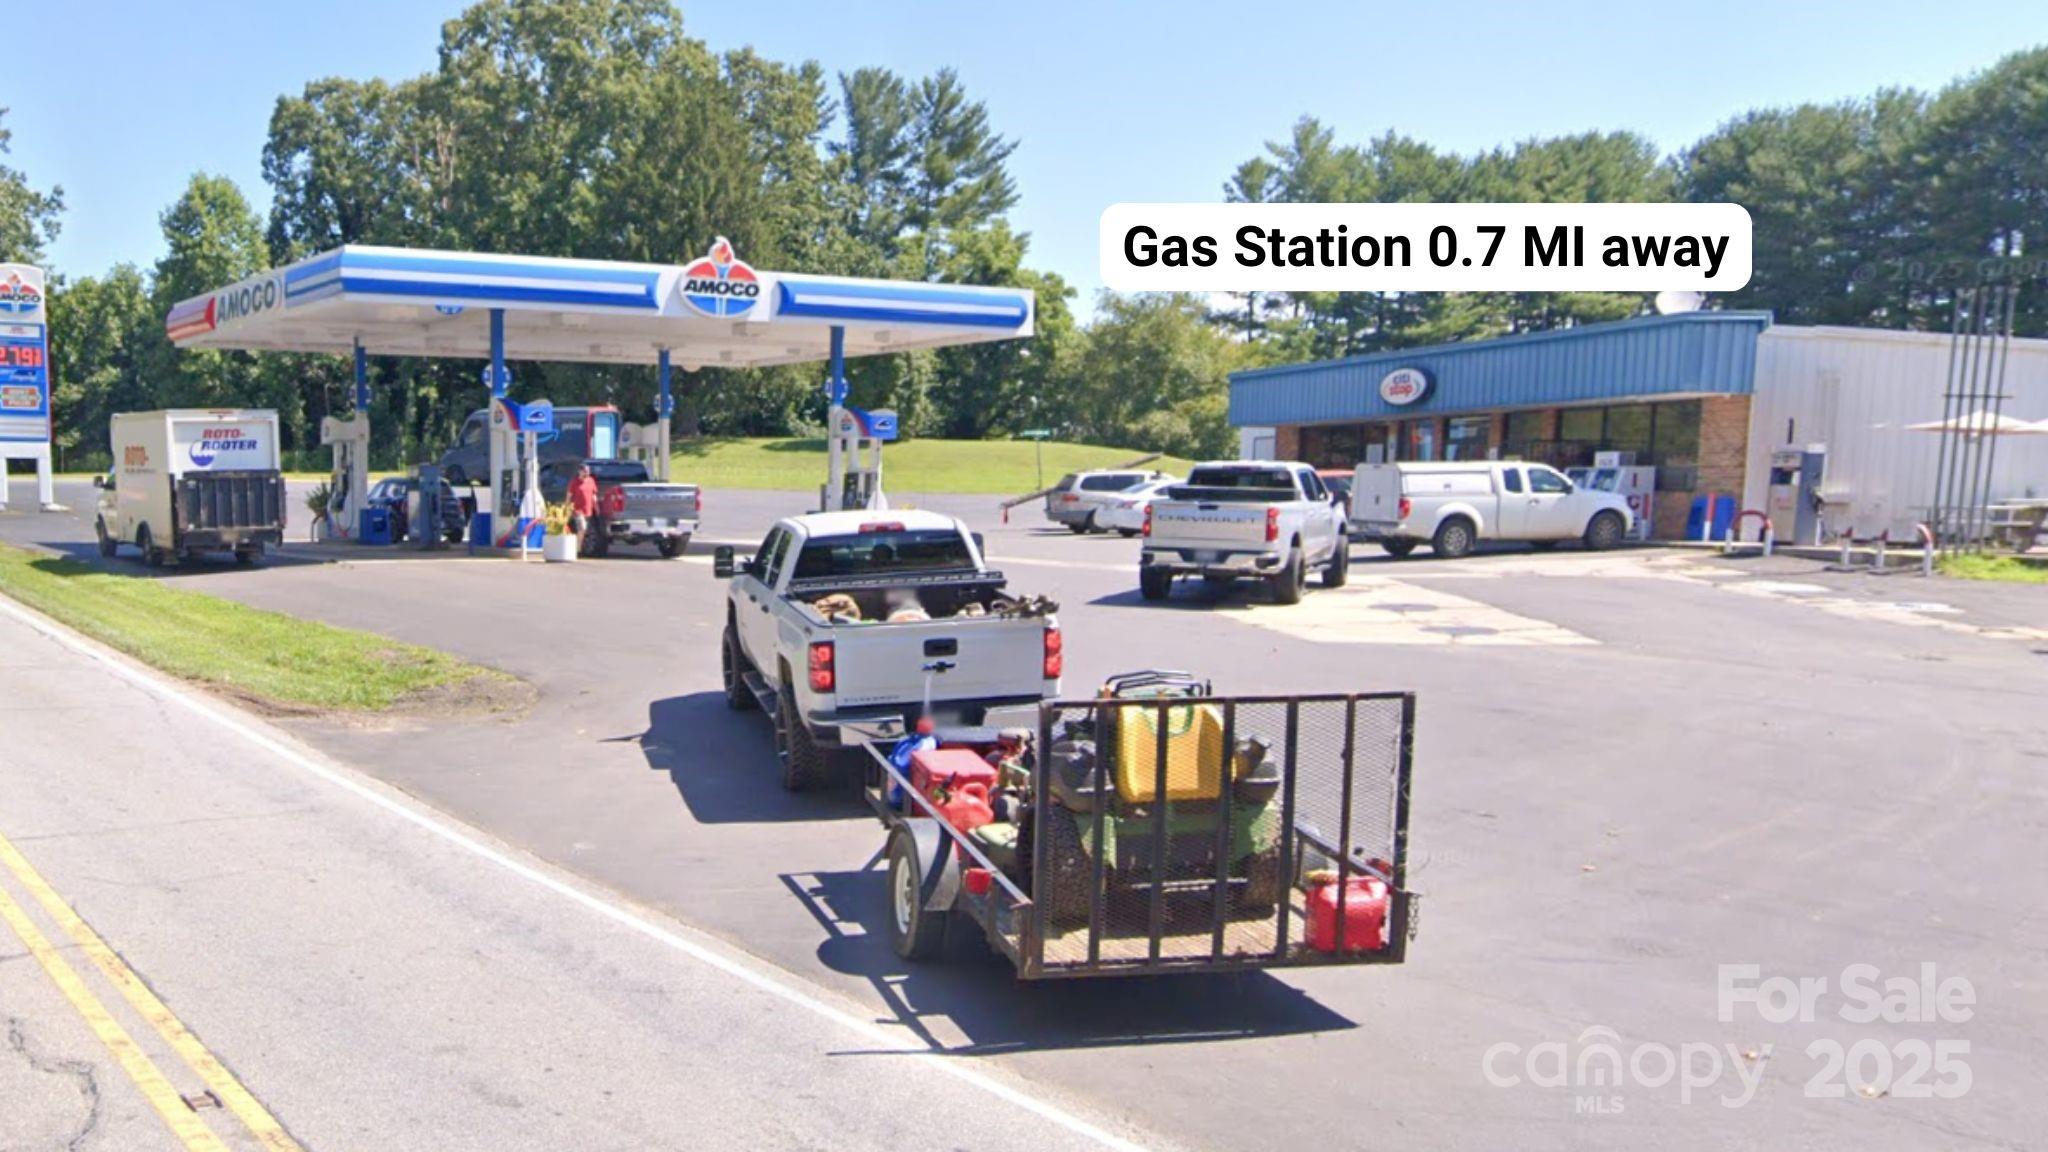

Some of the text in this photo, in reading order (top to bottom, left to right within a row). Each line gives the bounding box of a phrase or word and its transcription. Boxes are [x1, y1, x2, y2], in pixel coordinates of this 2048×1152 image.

[683, 279, 760, 297] AMOCO
[216, 280, 275, 322] AMOCO
[202, 428, 246, 439] ROTO-
[201, 440, 258, 451] ROOTER
